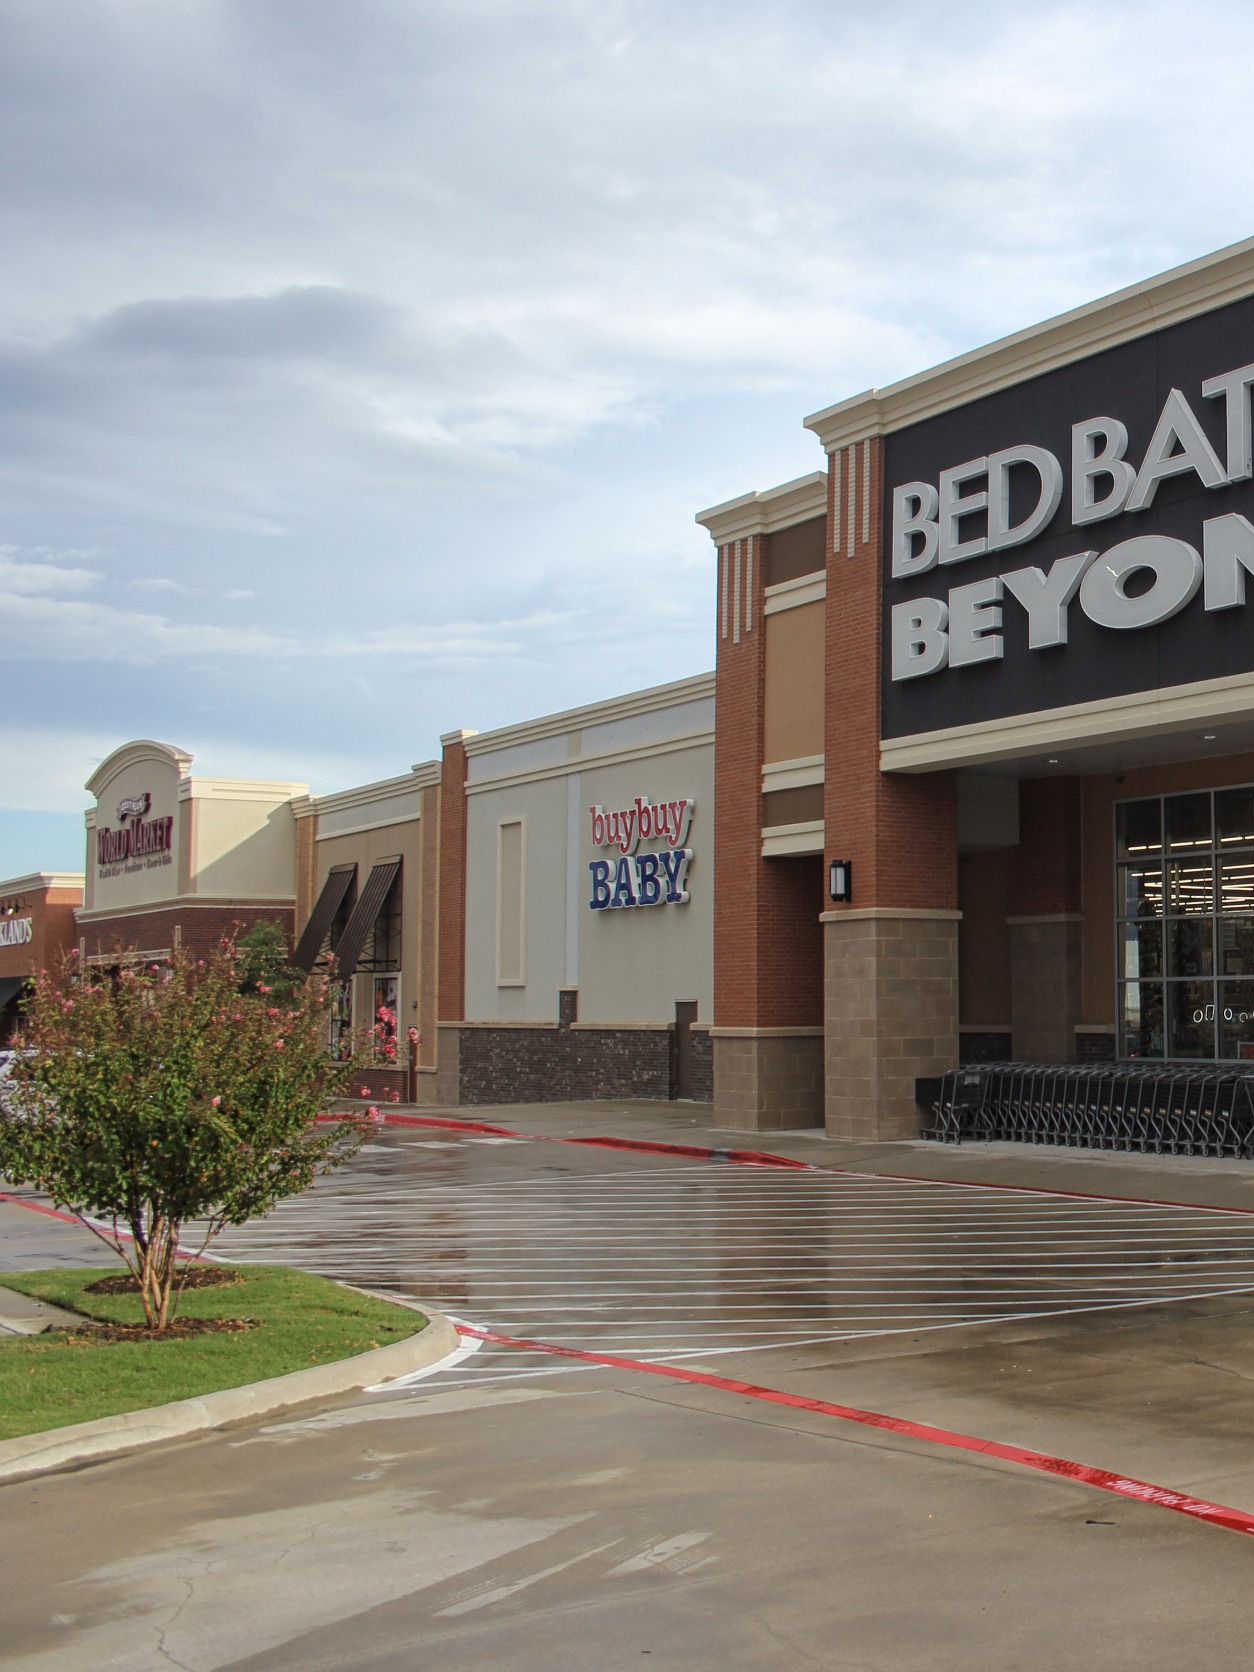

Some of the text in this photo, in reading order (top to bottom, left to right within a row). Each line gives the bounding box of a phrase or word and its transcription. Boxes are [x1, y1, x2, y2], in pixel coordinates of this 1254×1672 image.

[892, 444, 1064, 579] BED
[589, 796, 693, 855] buybuy
[589, 849, 693, 911] BABY
[1183, 1504, 1225, 1516] NO
